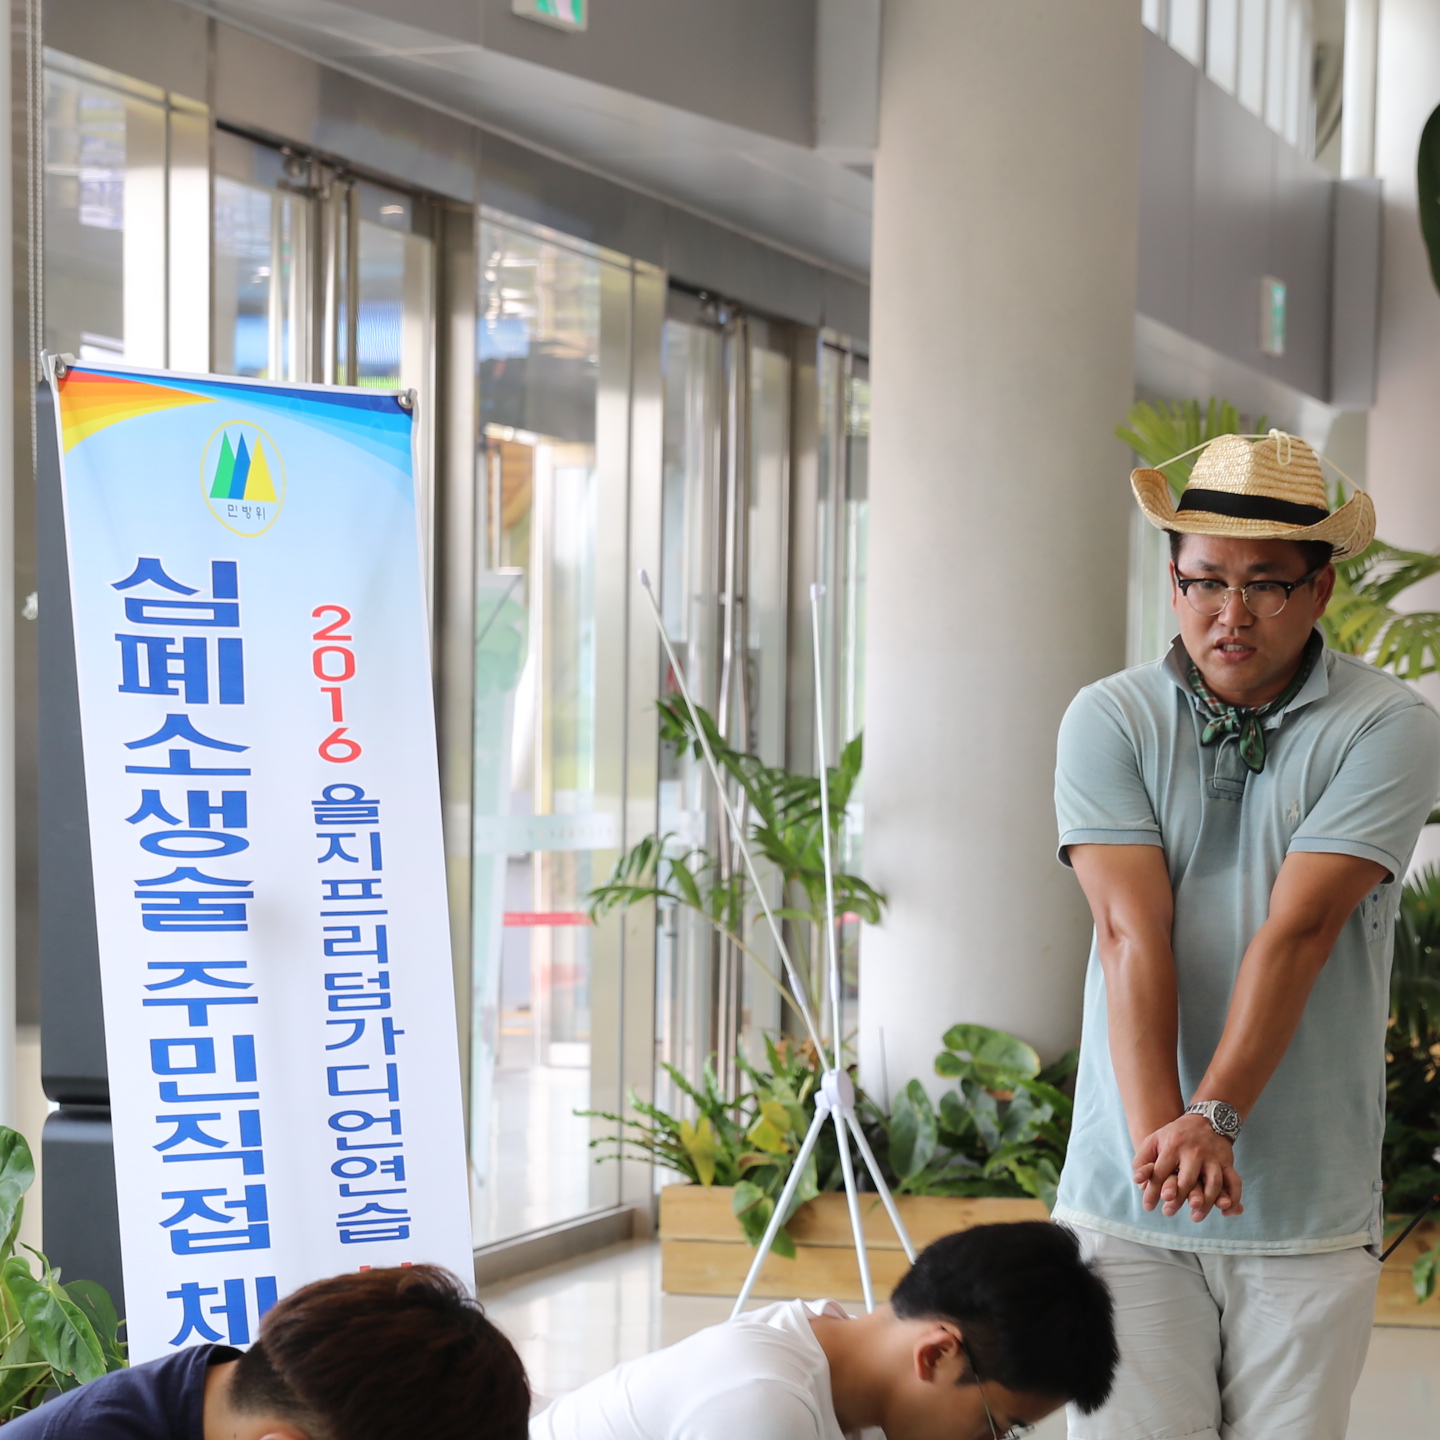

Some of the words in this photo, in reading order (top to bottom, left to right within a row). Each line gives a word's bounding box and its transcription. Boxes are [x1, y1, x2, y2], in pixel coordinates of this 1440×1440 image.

[227, 504, 266, 520] 민방위
[111, 557, 254, 932] 심폐소생술
[311, 604, 362, 764] 2016
[142, 960, 271, 1256] 주민직접
[311, 783, 411, 1244] 을지프리덤가디언연습
[166, 1275, 279, 1347] 체
